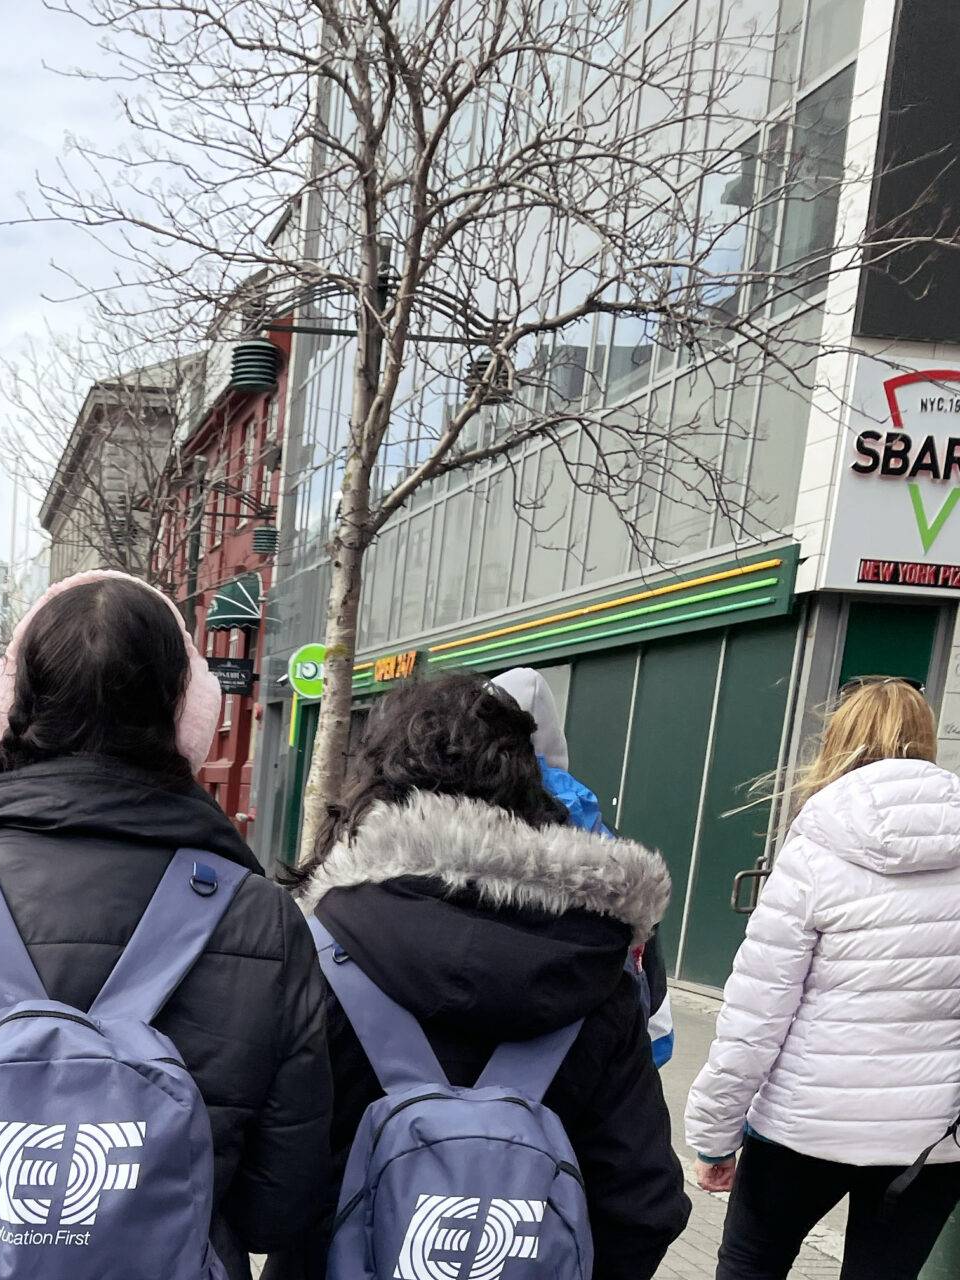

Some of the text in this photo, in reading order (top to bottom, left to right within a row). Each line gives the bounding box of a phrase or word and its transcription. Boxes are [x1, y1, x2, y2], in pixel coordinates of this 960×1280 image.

[858, 560, 894, 582] NEW
[897, 562, 937, 585] YORK
[54, 1230, 91, 1246] First
